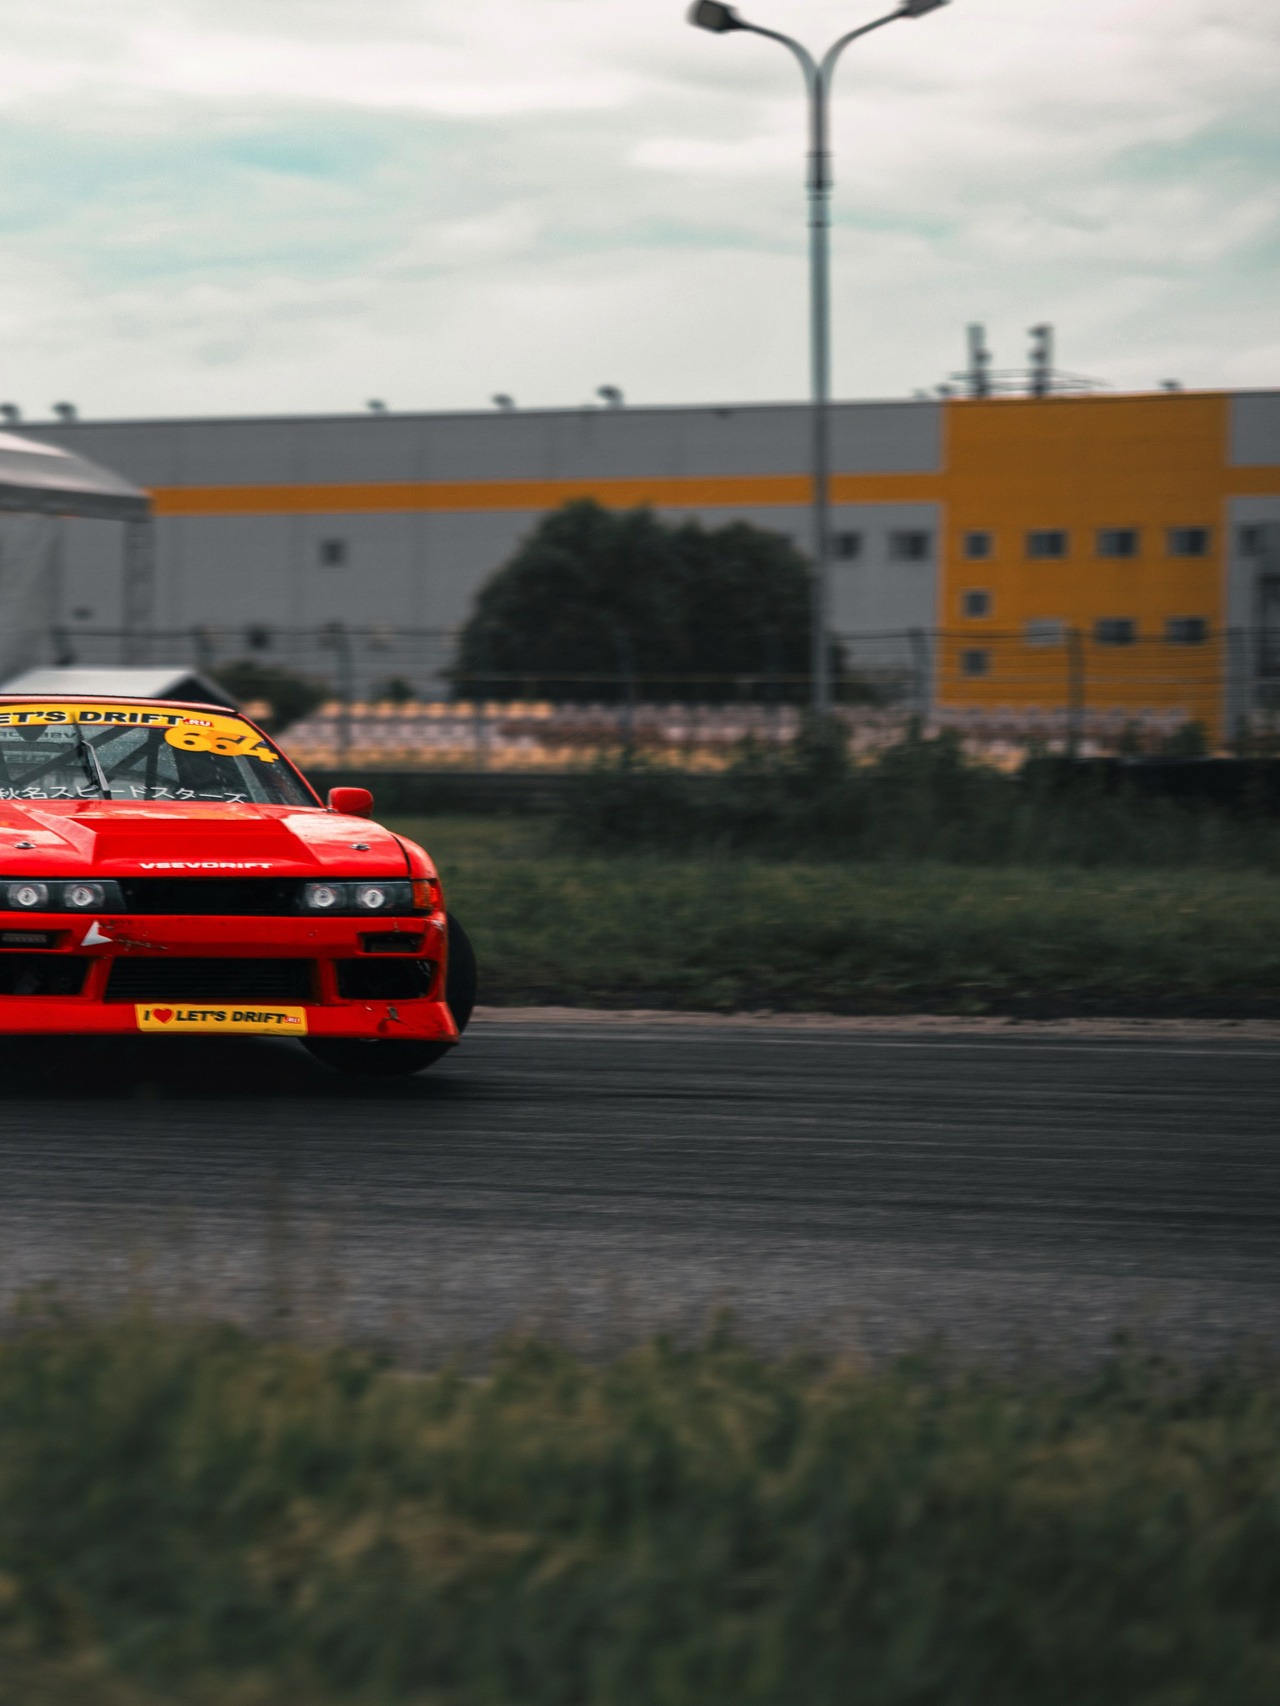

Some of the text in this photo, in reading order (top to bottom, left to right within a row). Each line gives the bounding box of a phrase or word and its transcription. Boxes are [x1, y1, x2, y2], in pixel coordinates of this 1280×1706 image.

[164, 727, 280, 763] 664
[144, 1010, 150, 1021] I
[176, 1010, 227, 1021] LET'S
